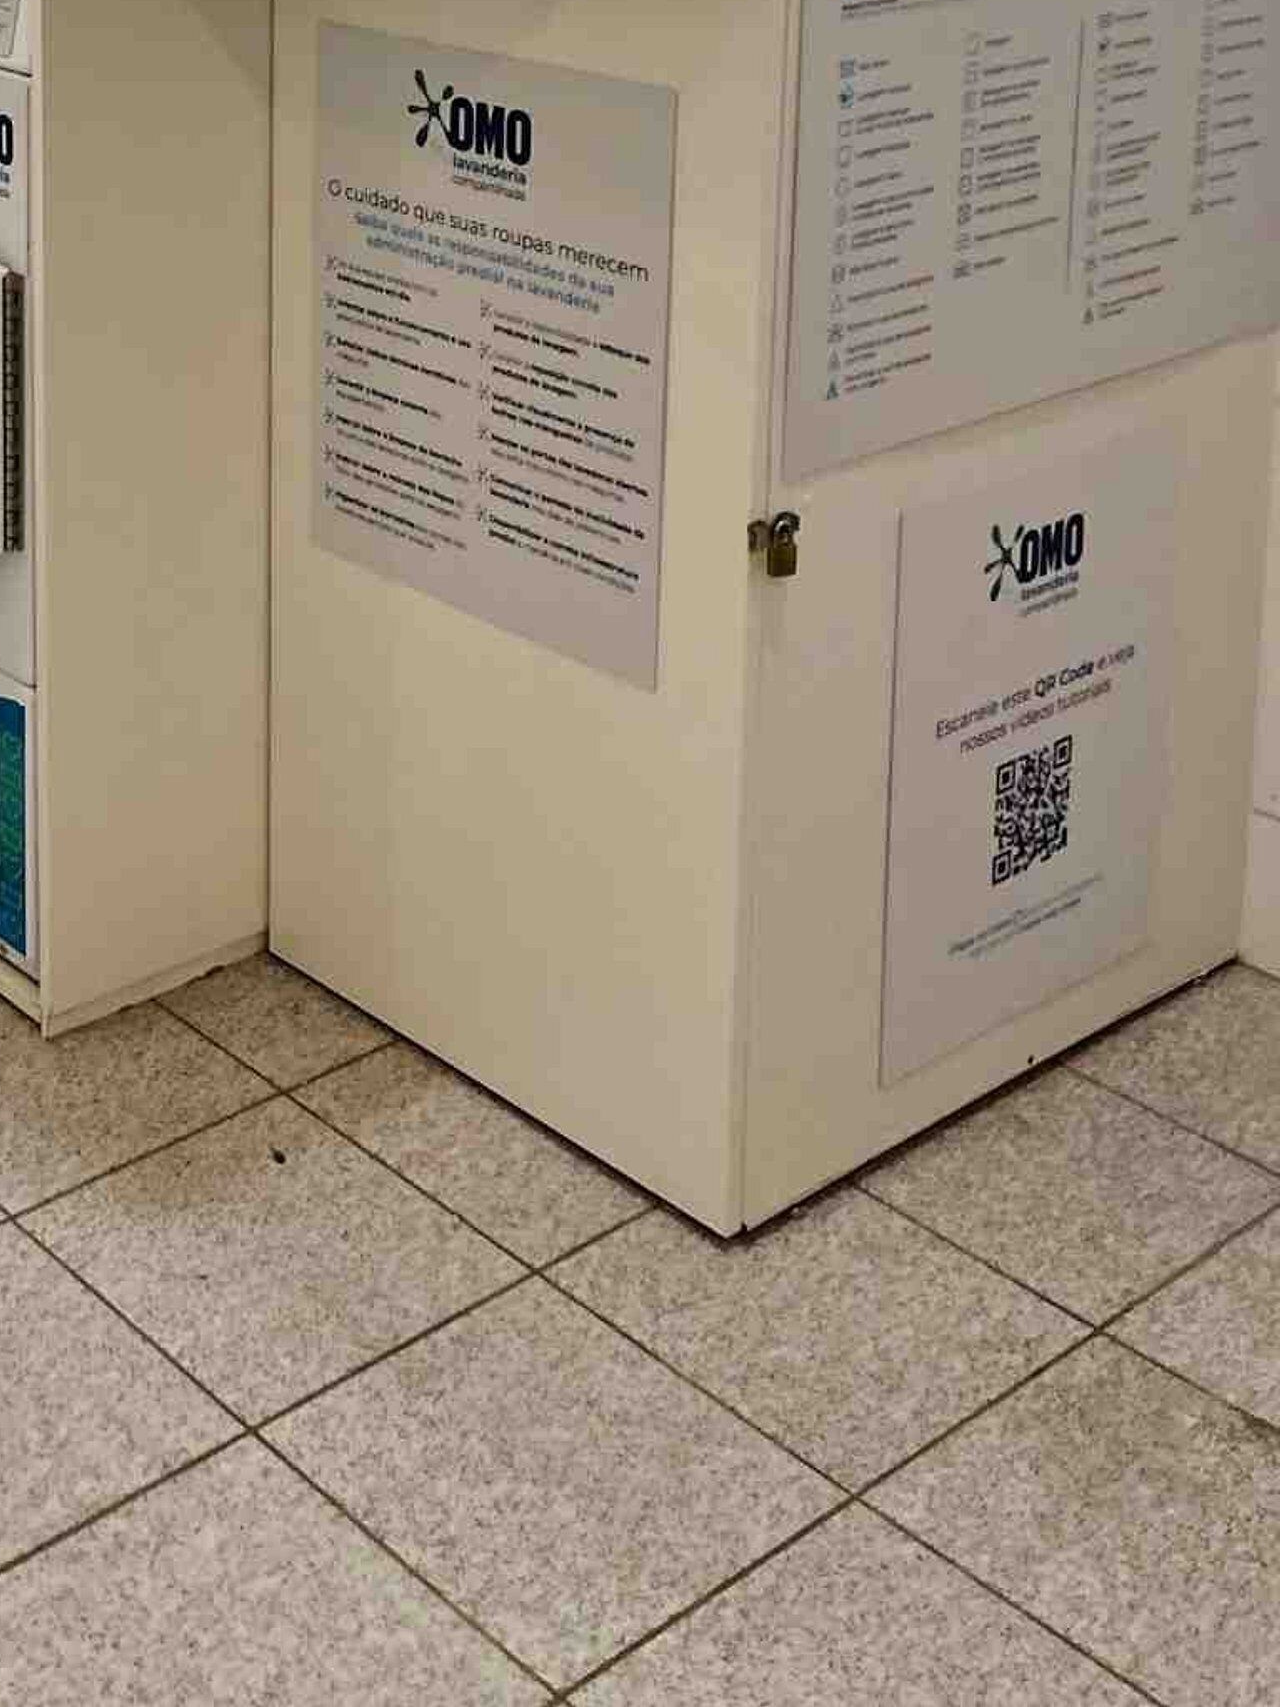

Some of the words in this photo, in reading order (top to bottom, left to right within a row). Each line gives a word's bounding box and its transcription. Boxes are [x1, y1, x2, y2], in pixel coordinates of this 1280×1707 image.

[449, 95, 533, 166] OMO
[453, 152, 527, 186] lavanderia
[328, 178, 342, 196] O
[345, 185, 410, 217] cuidado
[413, 203, 445, 225] que
[449, 213, 488, 238] suas
[492, 226, 555, 255] roupas
[558, 243, 649, 282] merecem
[527, 278, 601, 313] lavanderia
[1019, 512, 1084, 584] OMO
[1034, 674, 1057, 698] QR
[1058, 661, 1095, 687] Code
[959, 723, 1008, 755] nossos
